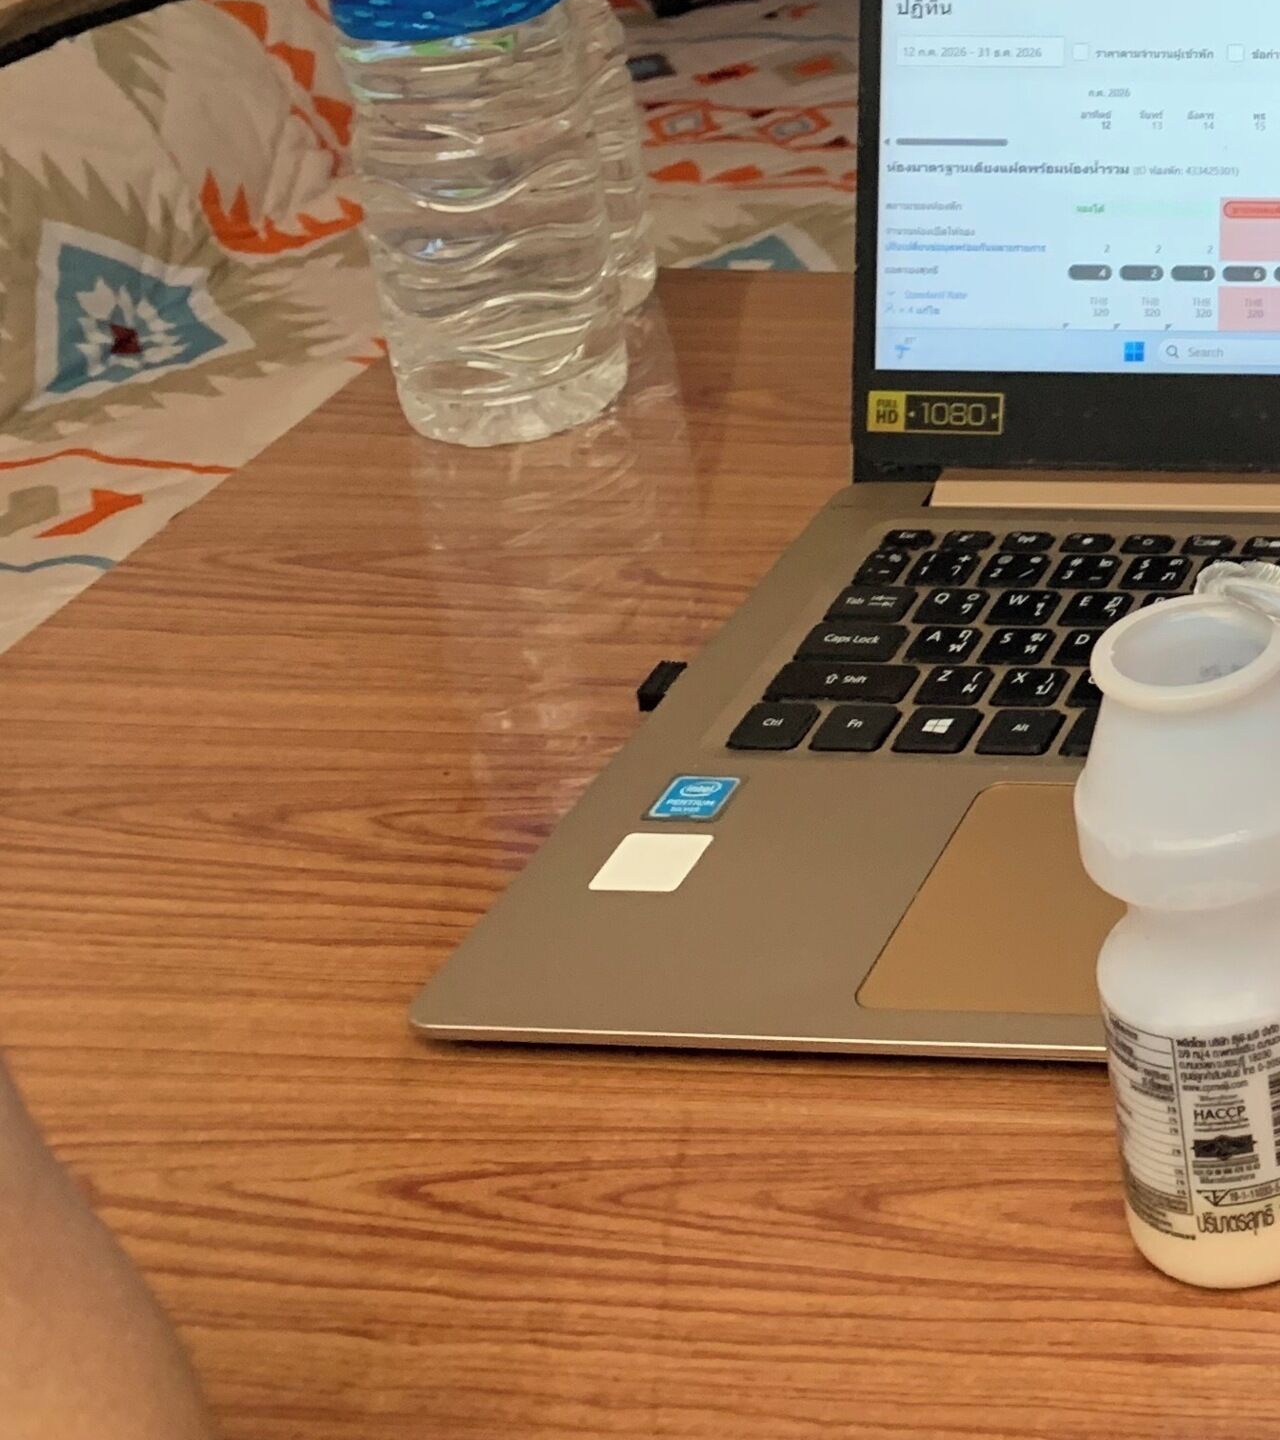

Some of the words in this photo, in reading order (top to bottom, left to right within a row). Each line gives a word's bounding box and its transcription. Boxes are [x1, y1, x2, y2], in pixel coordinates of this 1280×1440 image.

[904, 47, 915, 57] 12
[940, 47, 967, 57] 2026
[977, 47, 991, 57] 31
[1015, 47, 1042, 58] 2026
[1108, 88, 1130, 98] 2026
[1101, 121, 1111, 130] 12
[1188, 347, 1224, 358] Search
[876, 409, 898, 424] HD
[922, 403, 986, 426] 1080
[846, 596, 865, 605] Tab
[934, 592, 950, 604] Q
[1009, 594, 1030, 605] W
[1079, 595, 1093, 606] E
[824, 633, 851, 644] Caps
[852, 634, 880, 644] Lock
[926, 630, 942, 642] A
[1000, 632, 1013, 643] S
[1074, 634, 1090, 645] D
[842, 674, 868, 684] Shift
[937, 670, 953, 682] Z
[1011, 672, 1029, 684] X
[762, 717, 784, 727] Ctrl
[847, 719, 864, 728] Fn
[1011, 723, 1029, 732] Alt
[1194, 1105, 1246, 1121] HACCP
[1196, 1204, 1275, 1236] ปริมาตรสุทธิ
